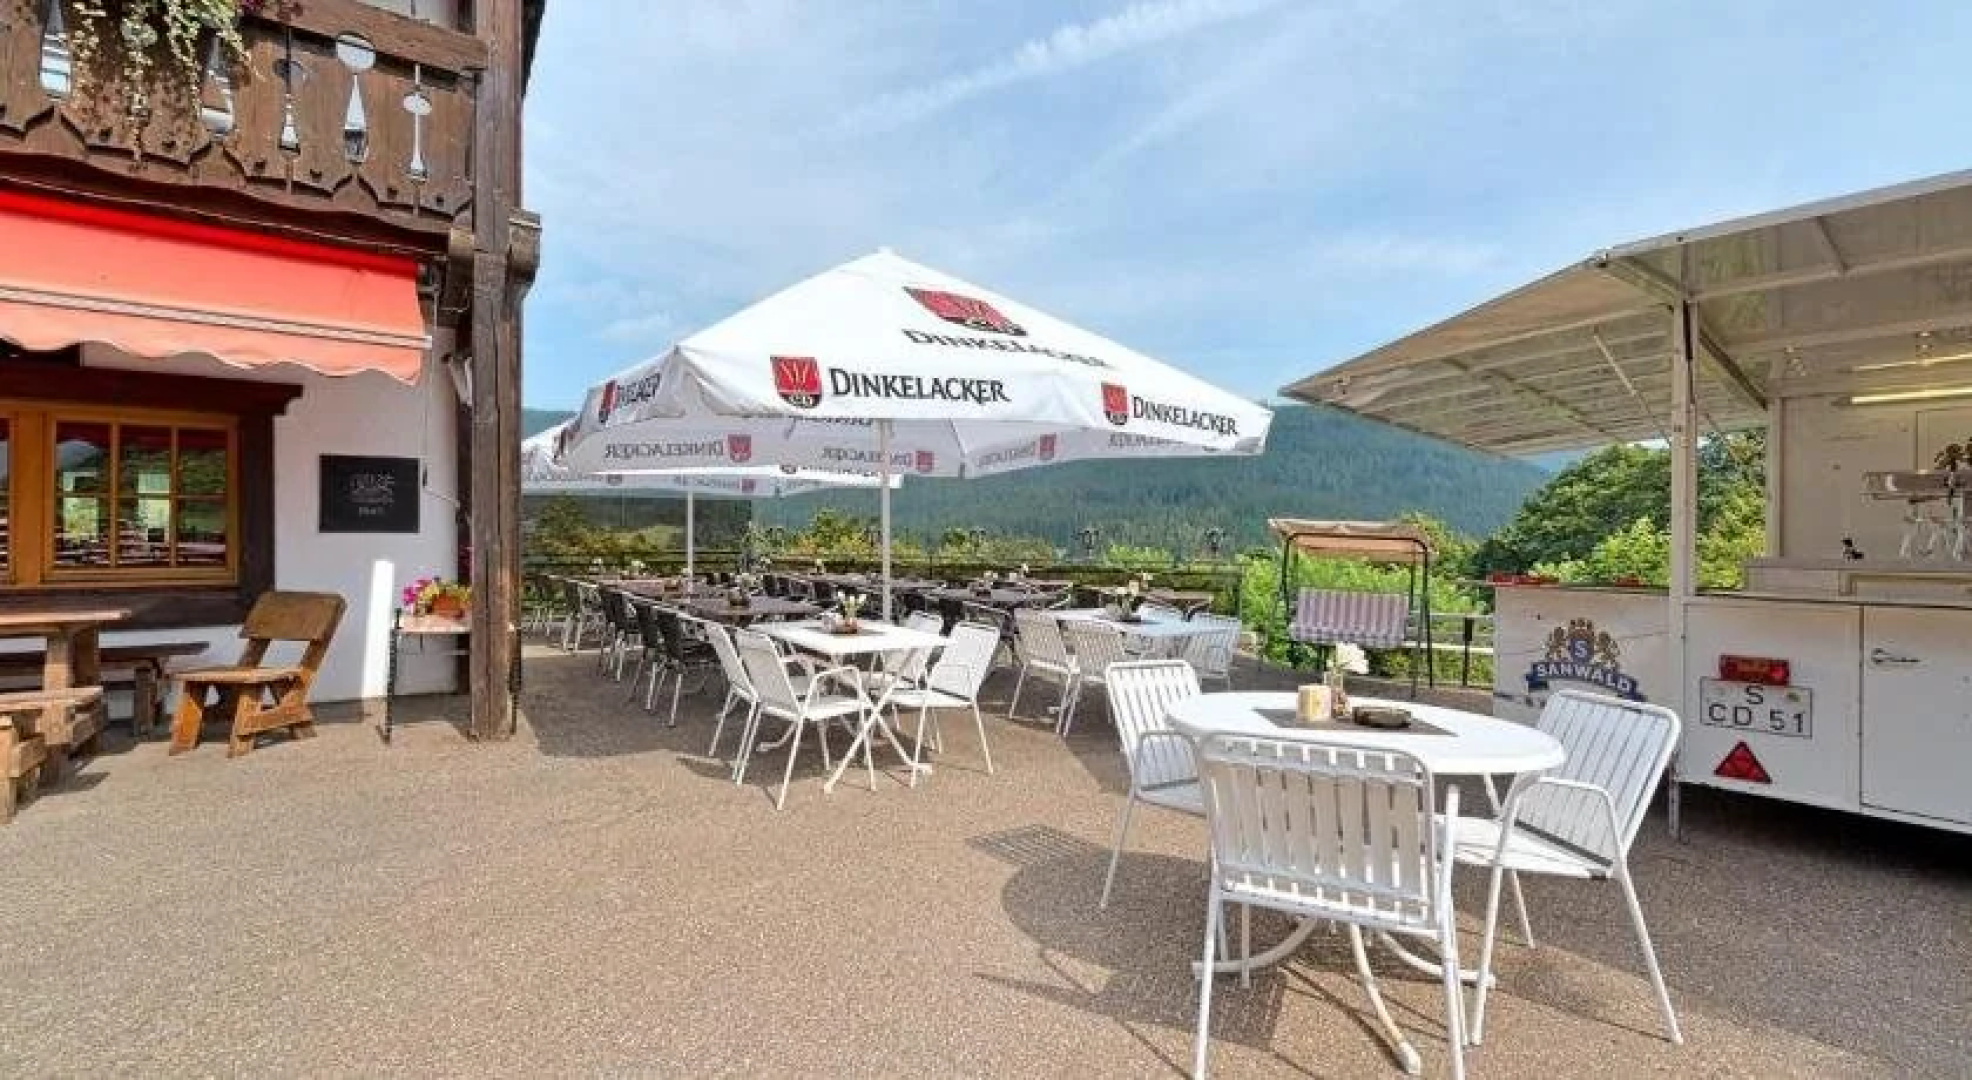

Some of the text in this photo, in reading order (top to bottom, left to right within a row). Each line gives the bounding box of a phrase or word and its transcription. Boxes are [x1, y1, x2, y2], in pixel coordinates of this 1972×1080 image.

[828, 367, 1012, 405] DINKELACKER
[1132, 395, 1238, 435] DINKELACKER
[1574, 640, 1588, 658] S
[1537, 662, 1632, 692] SANWALD
[1745, 685, 1764, 705] S
[1709, 703, 1805, 733] CD 51
